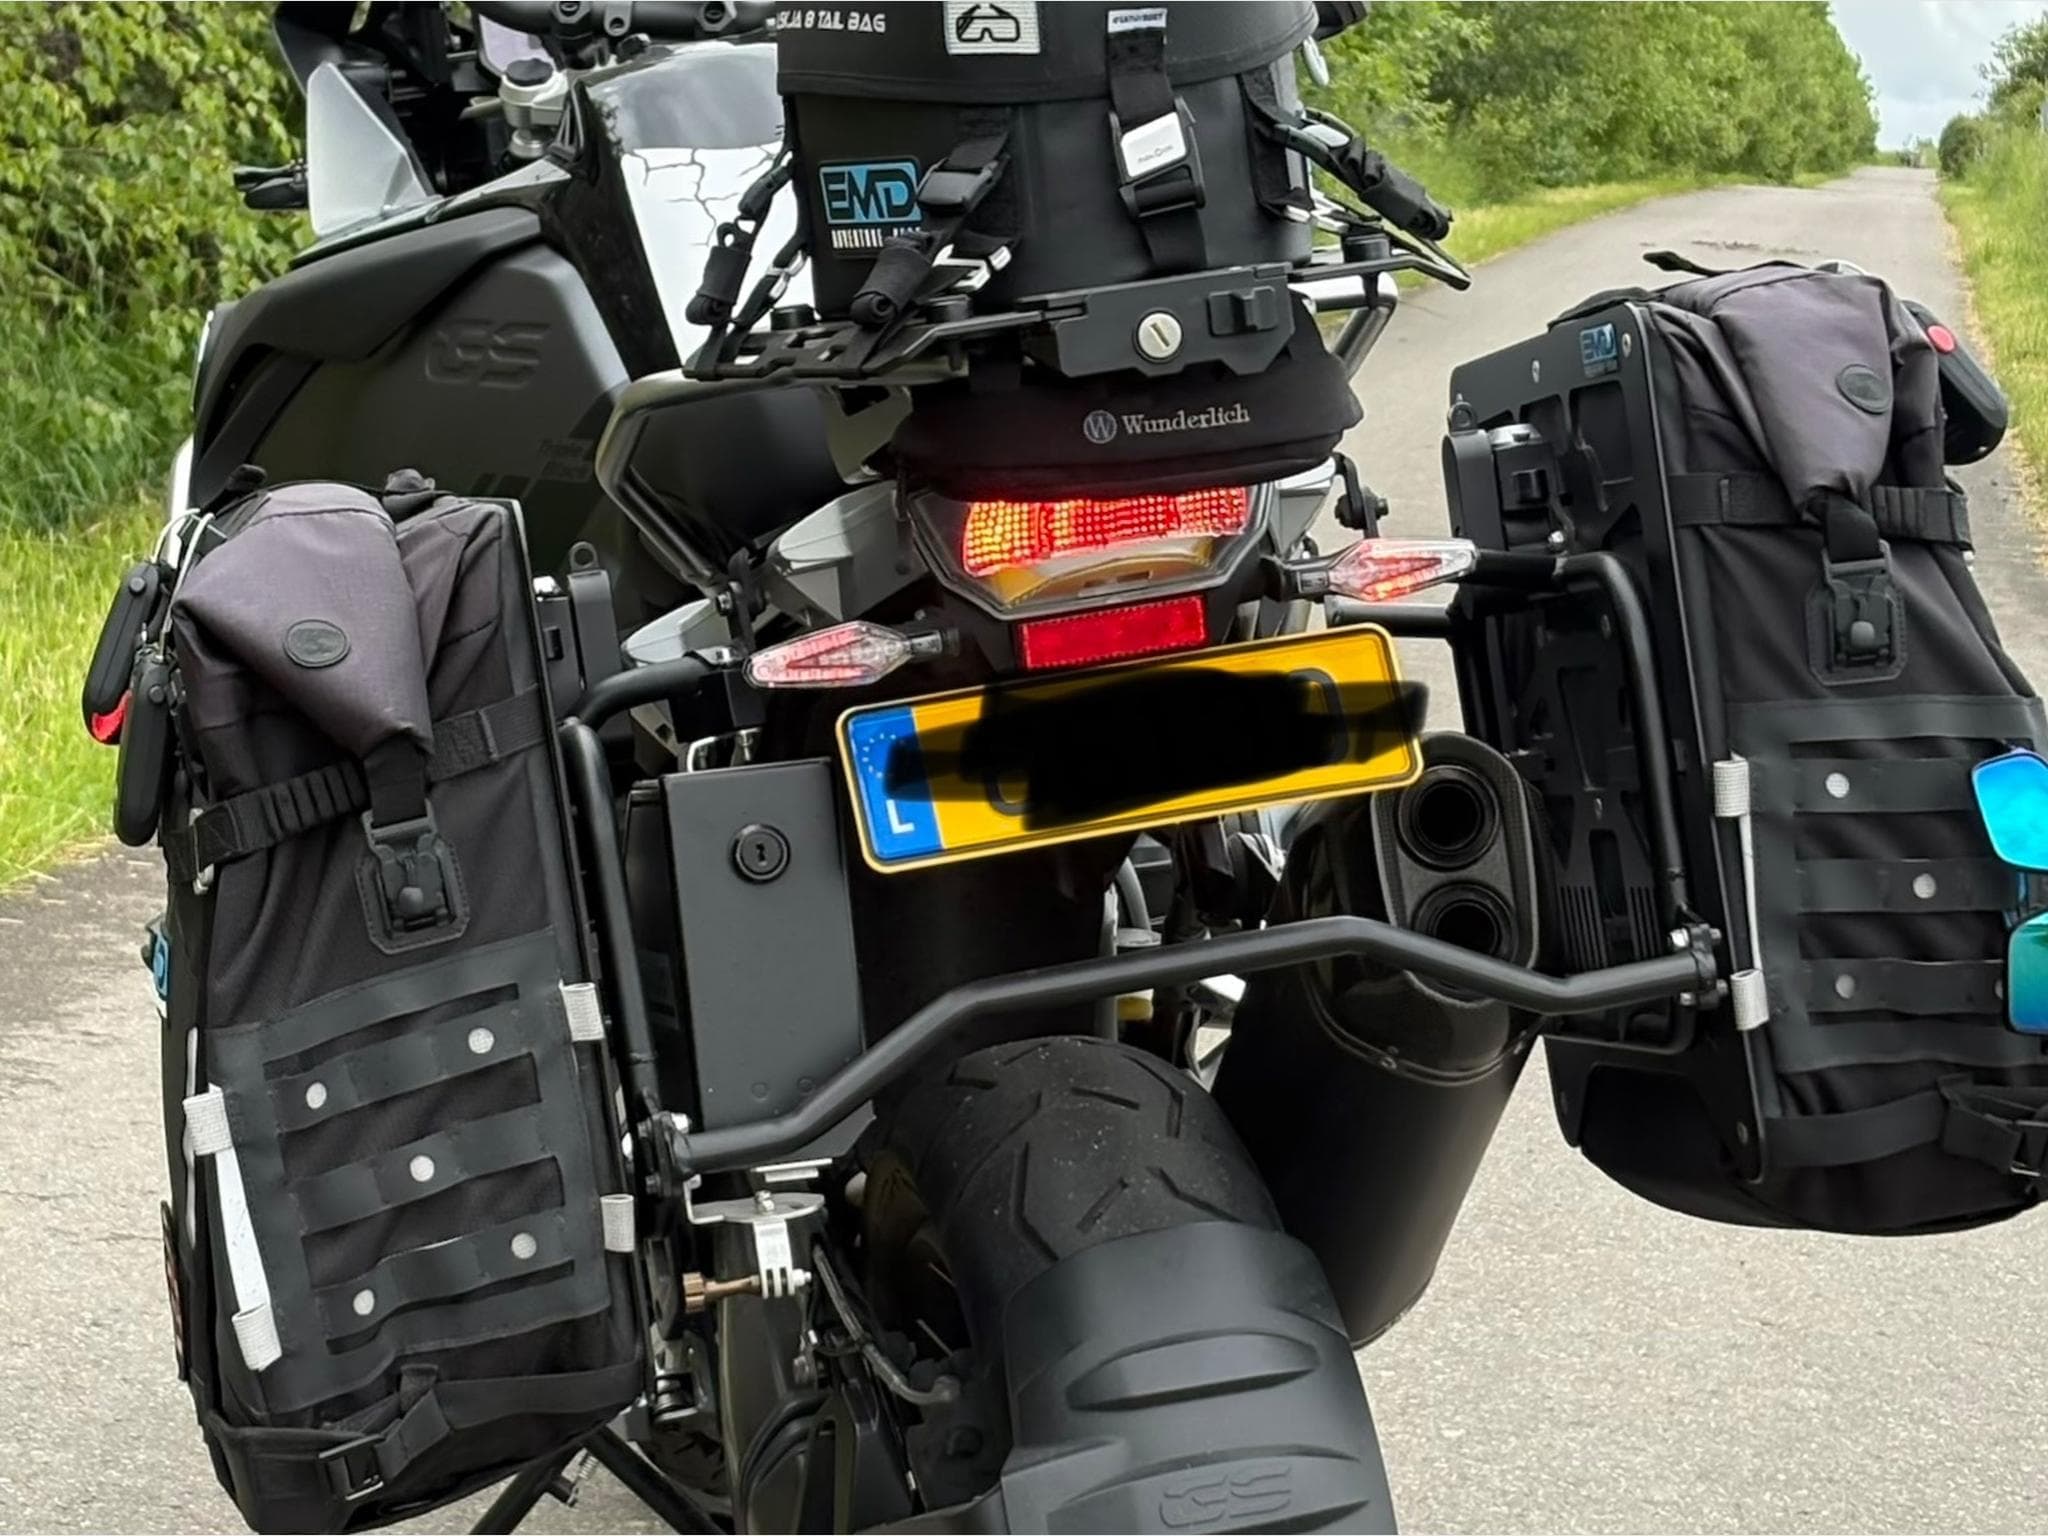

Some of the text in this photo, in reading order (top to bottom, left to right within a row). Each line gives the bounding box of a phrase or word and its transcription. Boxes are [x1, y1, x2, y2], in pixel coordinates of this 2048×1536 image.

[804, 10, 815, 29] 8
[847, 11, 886, 33] BAG
[823, 167, 917, 220] EMD
[425, 318, 549, 389] GS
[1122, 403, 1250, 435] Wunderlich
[886, 799, 915, 834] L
[1159, 1464, 1291, 1528] GS
